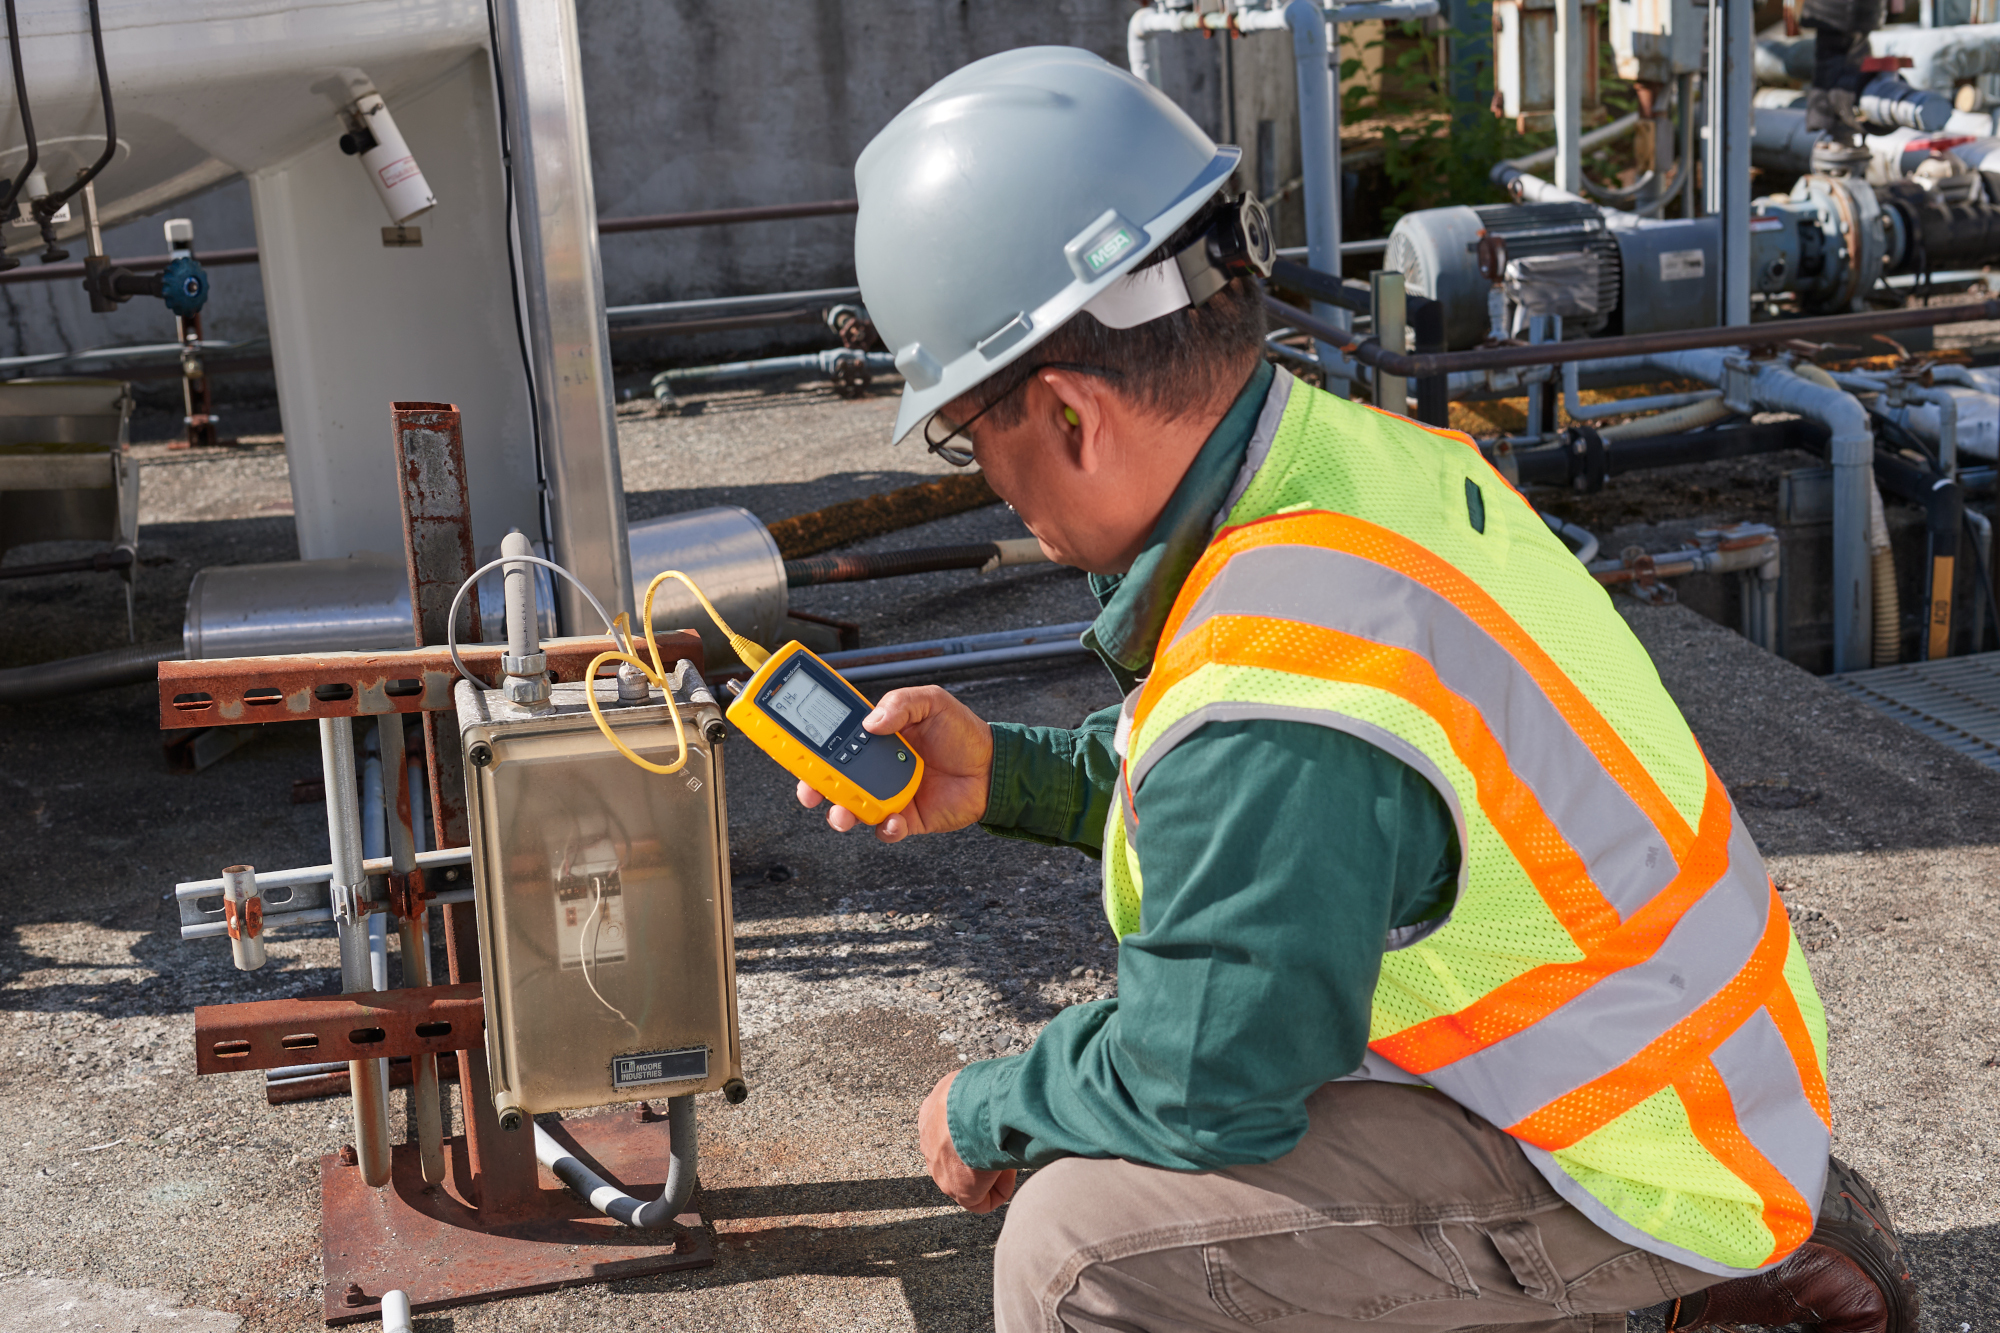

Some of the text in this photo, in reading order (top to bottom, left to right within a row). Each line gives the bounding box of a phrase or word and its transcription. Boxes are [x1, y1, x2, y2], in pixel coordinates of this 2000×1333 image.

[1091, 233, 1130, 267] MSA
[636, 1062, 662, 1072] MOORE
[621, 1069, 662, 1081] INDUSTRIES
